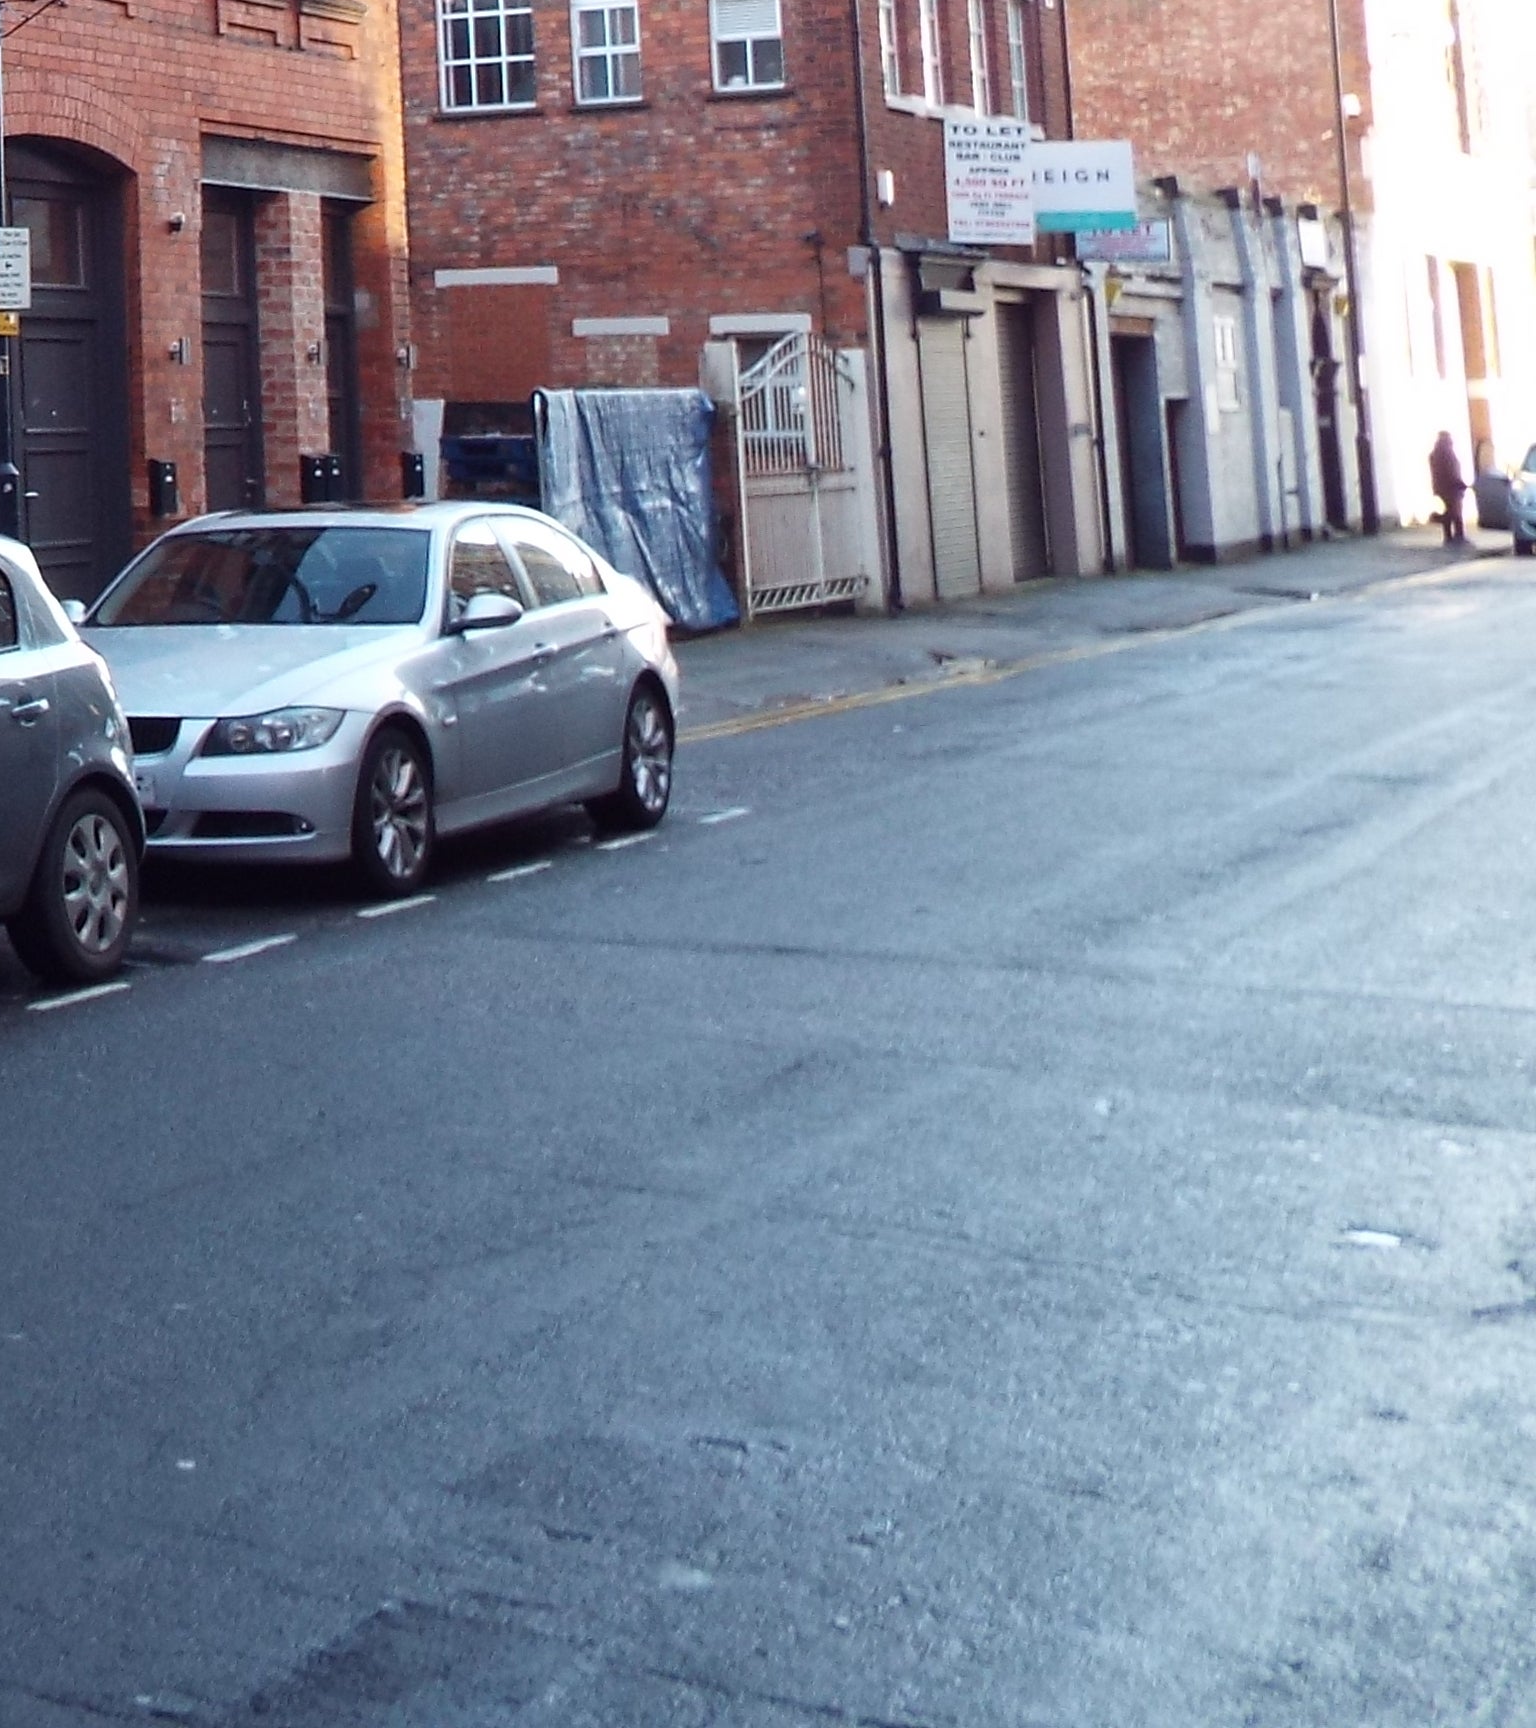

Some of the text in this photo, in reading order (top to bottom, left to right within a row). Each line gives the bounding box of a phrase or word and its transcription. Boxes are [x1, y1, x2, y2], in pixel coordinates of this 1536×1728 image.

[951, 125, 1024, 137] TO LET
[1031, 169, 1110, 184] EIGN
